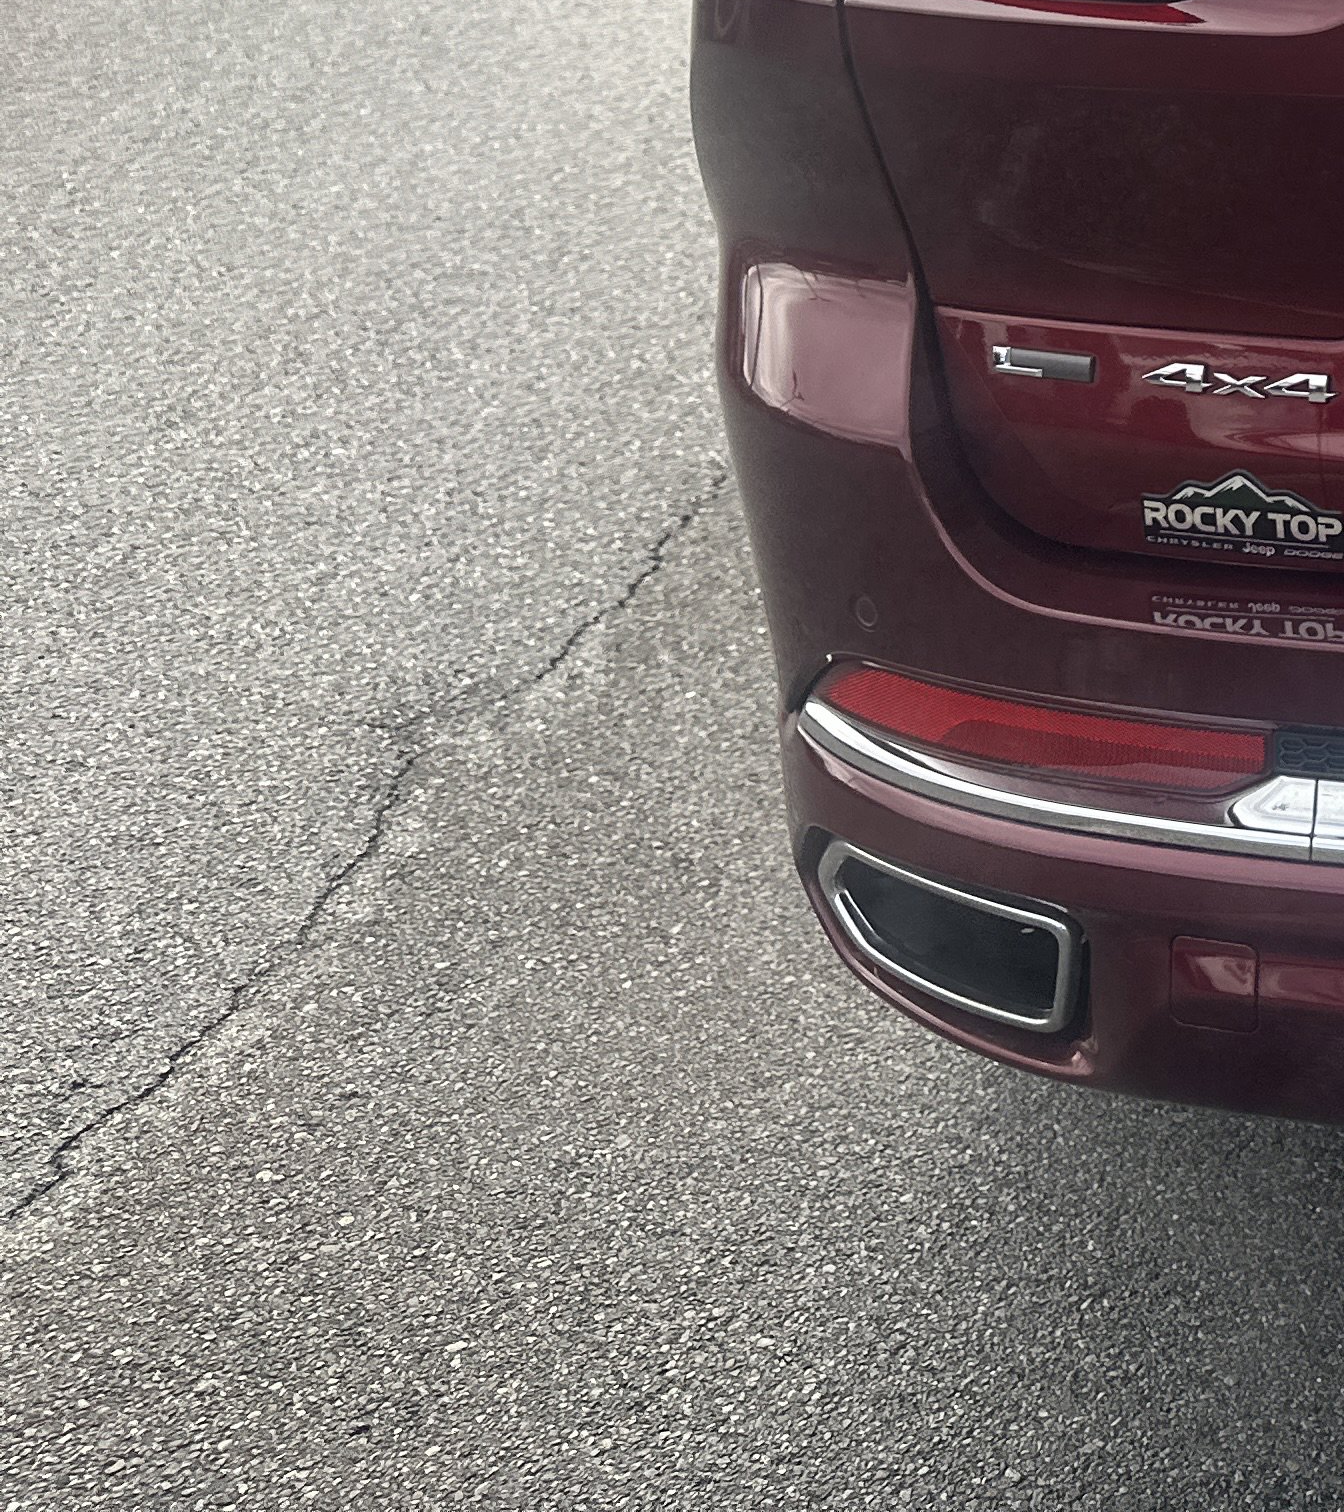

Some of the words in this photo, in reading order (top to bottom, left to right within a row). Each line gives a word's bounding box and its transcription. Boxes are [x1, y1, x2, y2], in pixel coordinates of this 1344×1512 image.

[1141, 361, 1339, 404] 4x4
[1143, 500, 1261, 536] ROCKY
[1267, 512, 1343, 543] TOP
[1146, 535, 1234, 551] CHRYSLER
[1242, 541, 1276, 558] Jeep
[1284, 549, 1344, 560] DODGE
